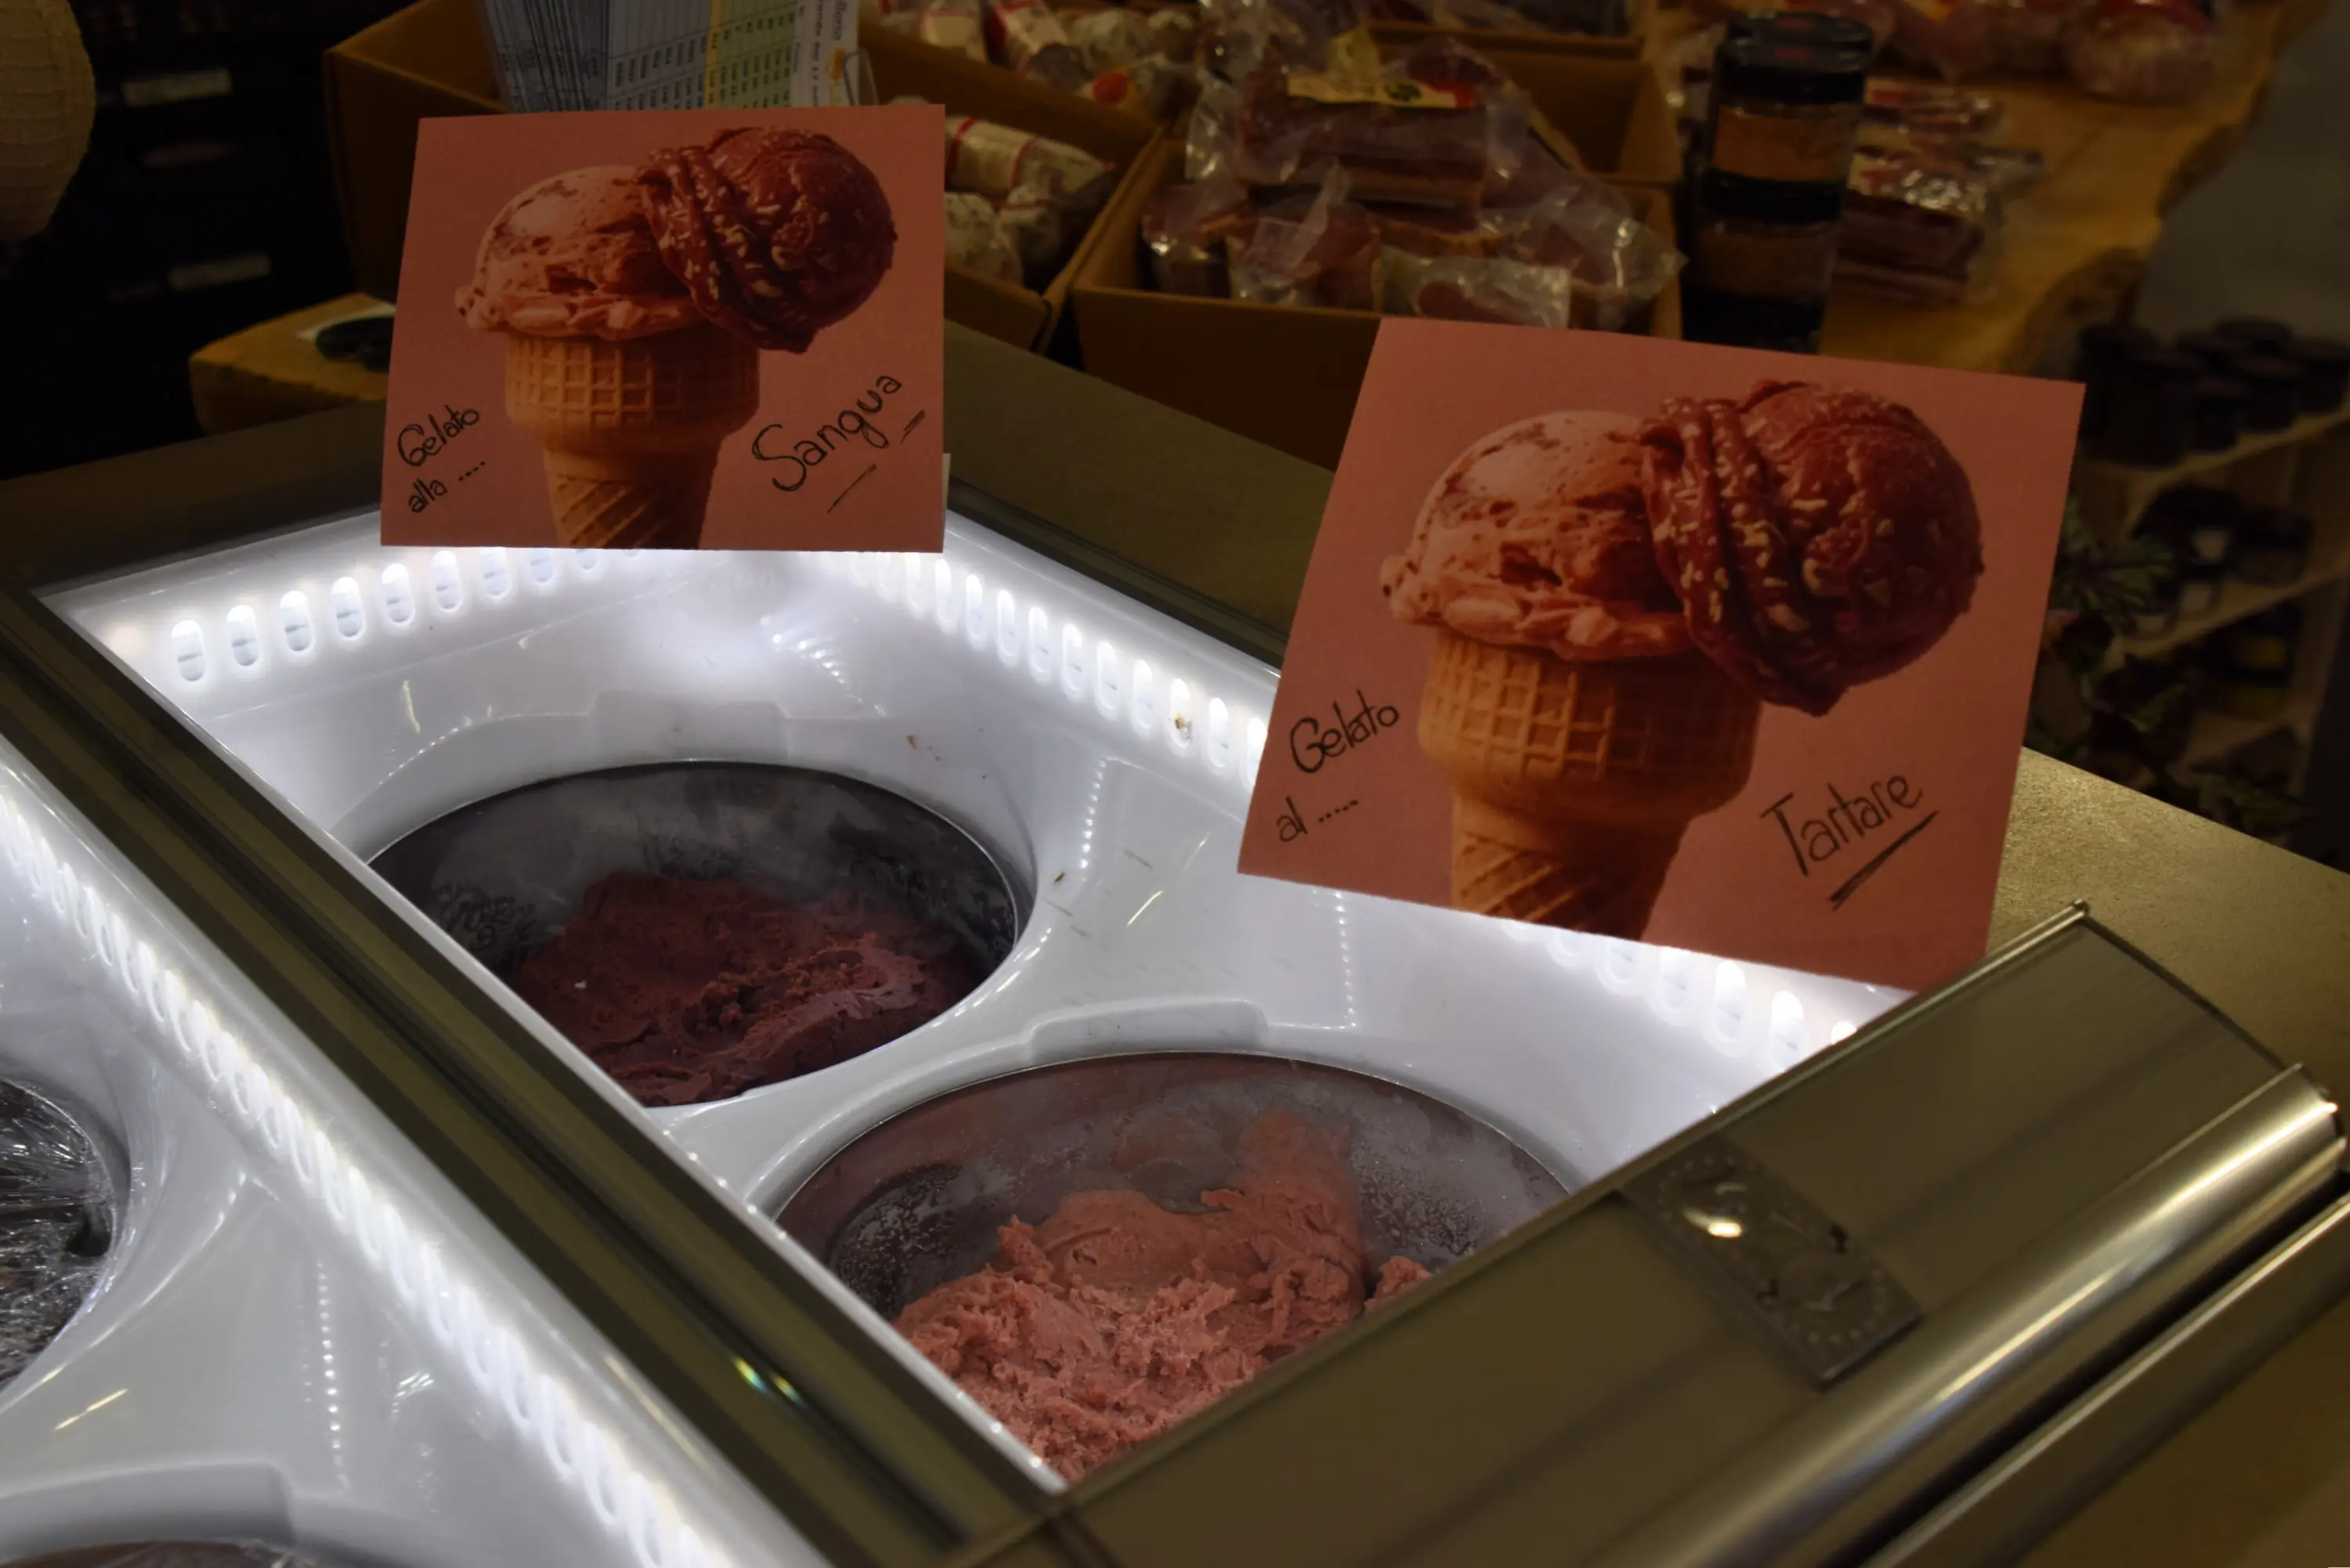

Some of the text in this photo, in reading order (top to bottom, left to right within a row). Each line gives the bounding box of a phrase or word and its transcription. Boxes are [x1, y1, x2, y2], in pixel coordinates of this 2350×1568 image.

[398, 404, 479, 467] Gelato
[408, 478, 448, 513] alla
[1289, 688, 1399, 774] Gelato
[1276, 796, 1307, 842] al
[1759, 775, 1923, 876] Tartare
